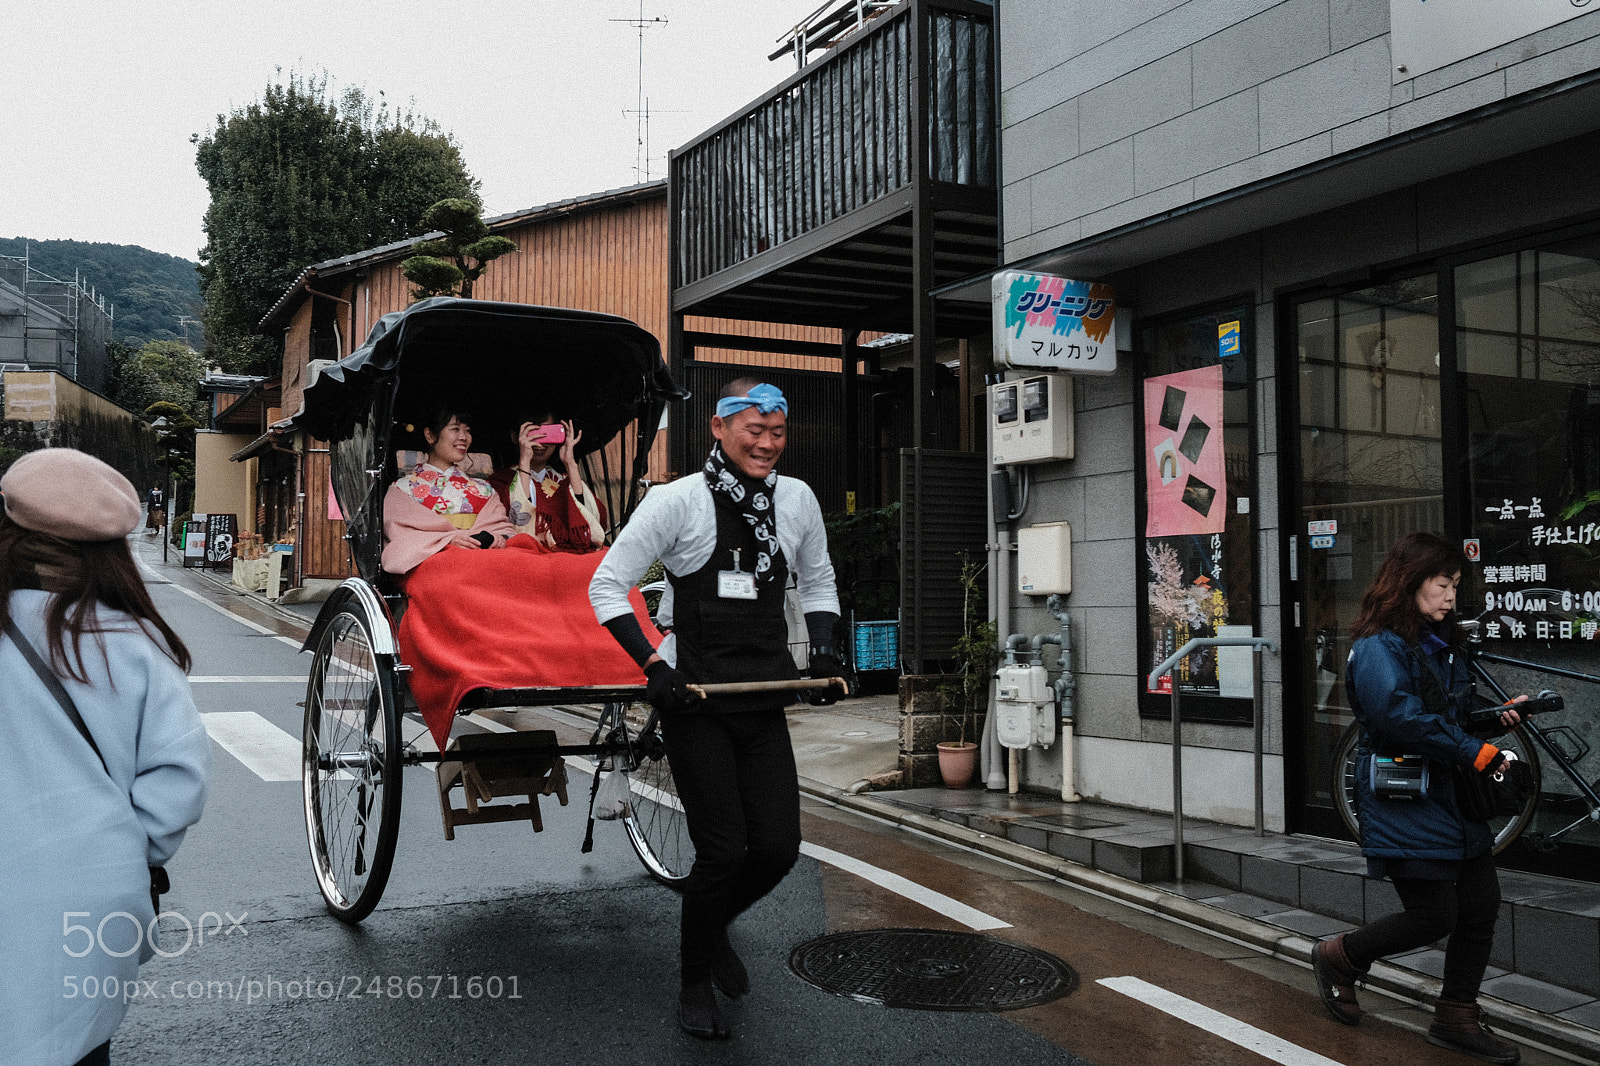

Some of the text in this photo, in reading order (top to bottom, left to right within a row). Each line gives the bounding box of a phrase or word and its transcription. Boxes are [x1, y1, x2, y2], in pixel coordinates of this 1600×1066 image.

[1016, 291, 1112, 320] クリーニング
[1031, 340, 1098, 360] マルカツ
[1485, 497, 1545, 520] 一点一点
[1483, 564, 1546, 583] 営業時間
